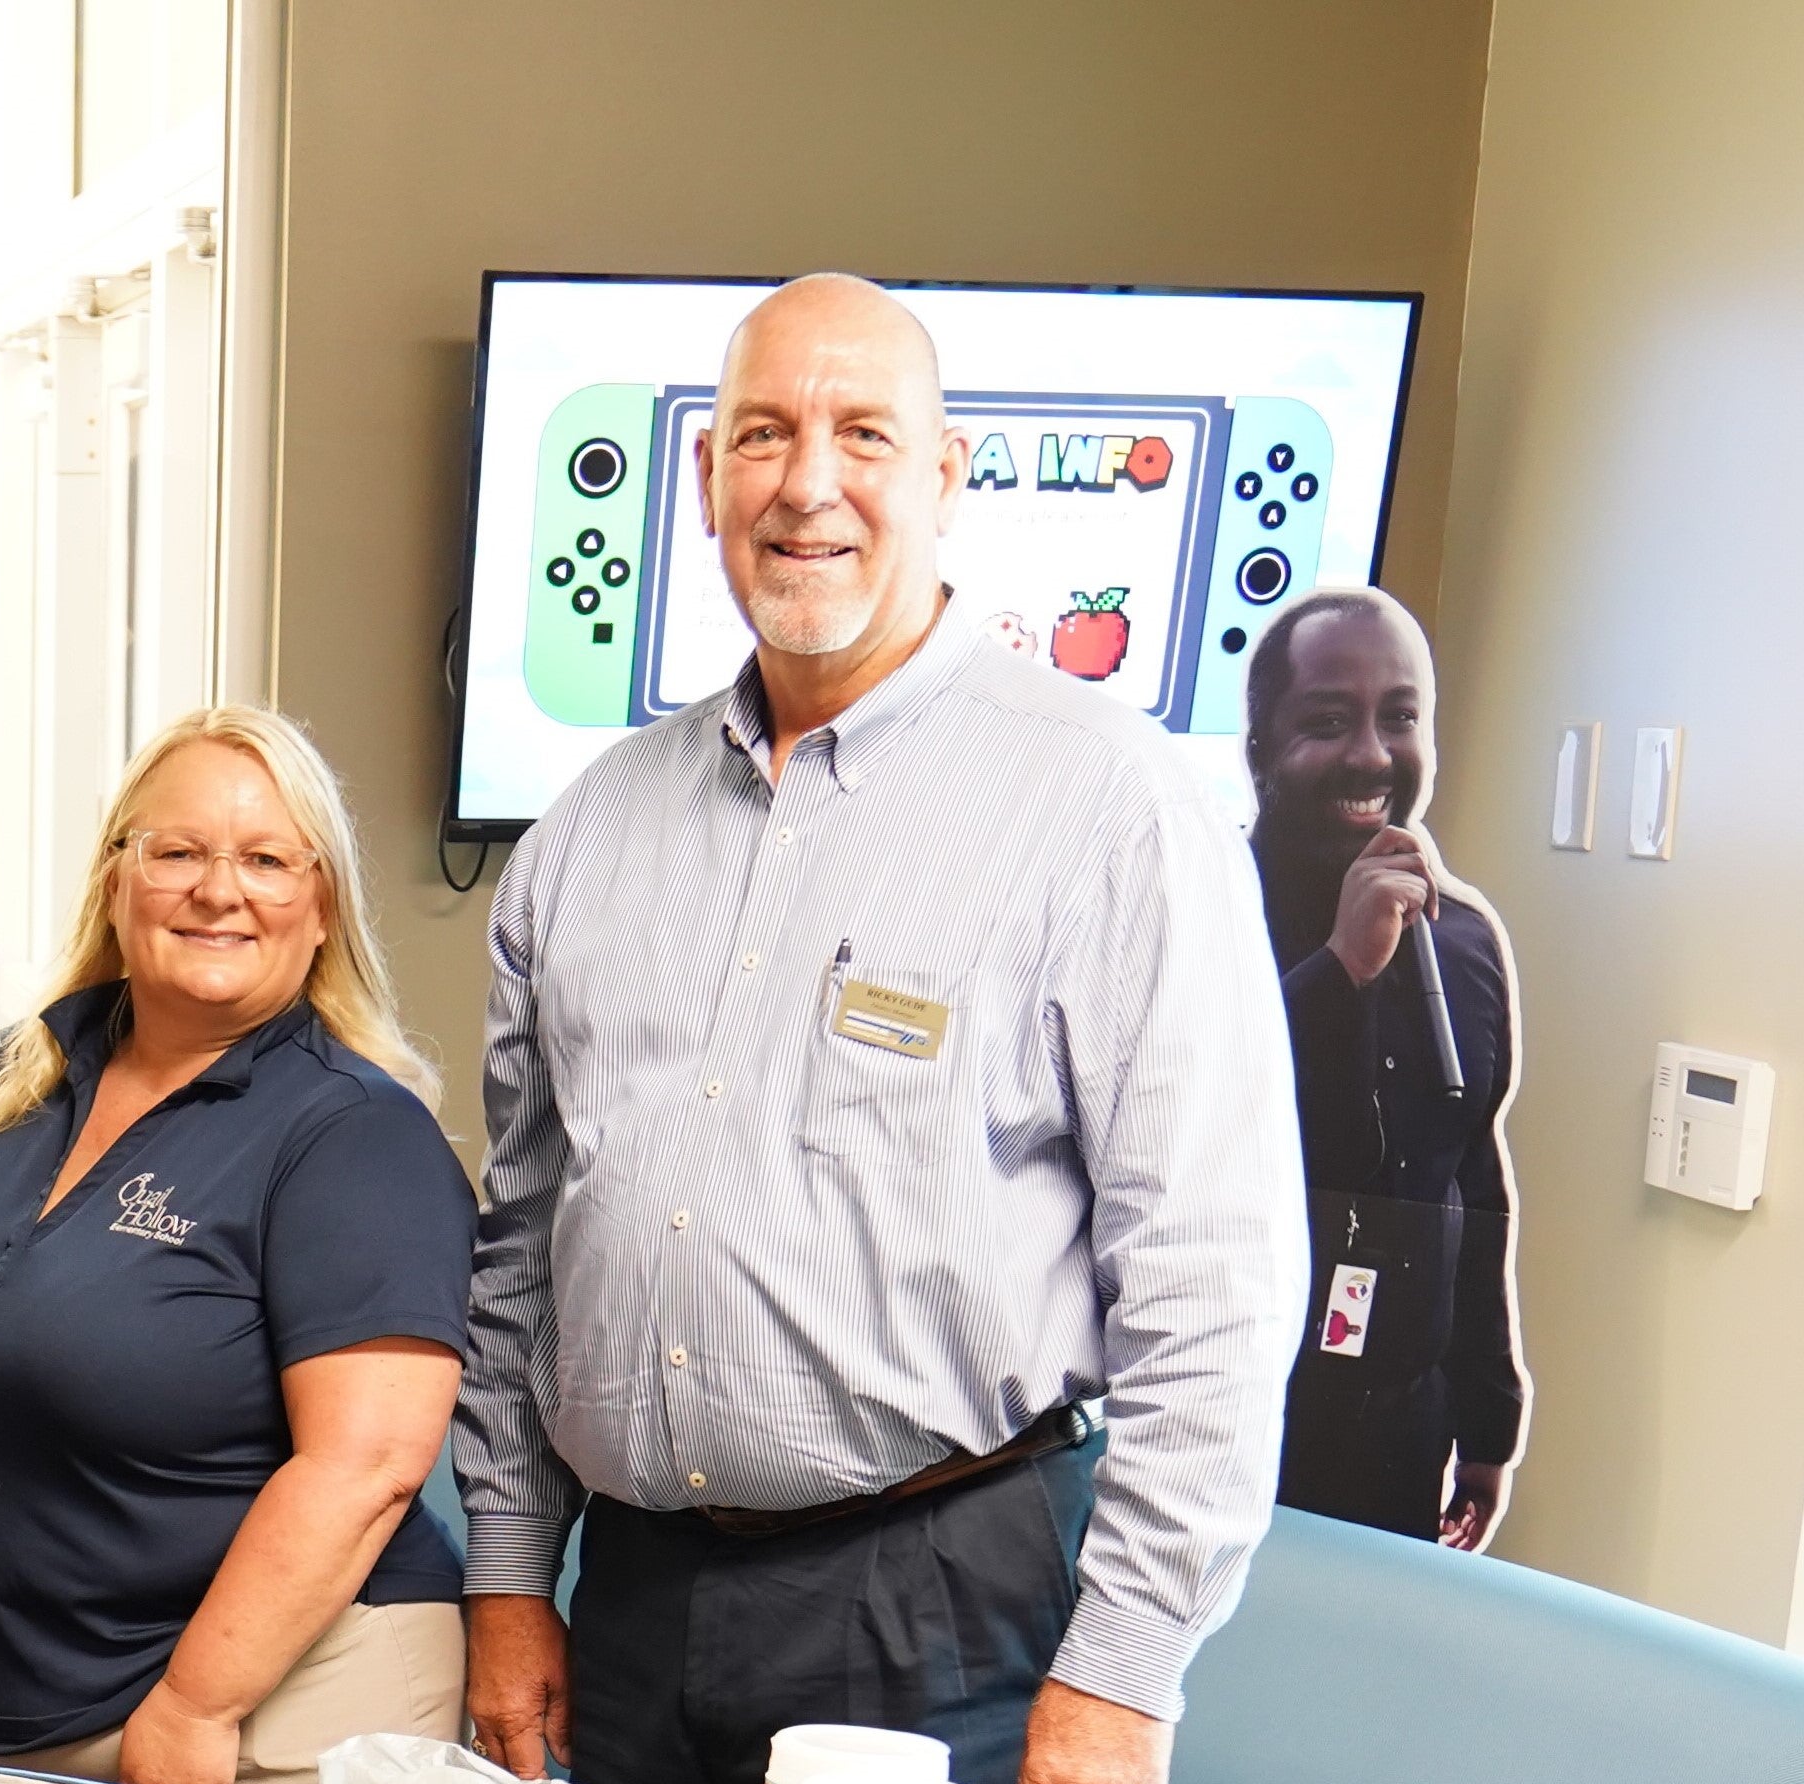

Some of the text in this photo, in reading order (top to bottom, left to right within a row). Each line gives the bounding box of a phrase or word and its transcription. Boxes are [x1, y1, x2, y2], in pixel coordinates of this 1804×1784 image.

[1037, 433, 1174, 493] INFO
[118, 1172, 176, 1208] Quail
[116, 1202, 197, 1237] Hollow
